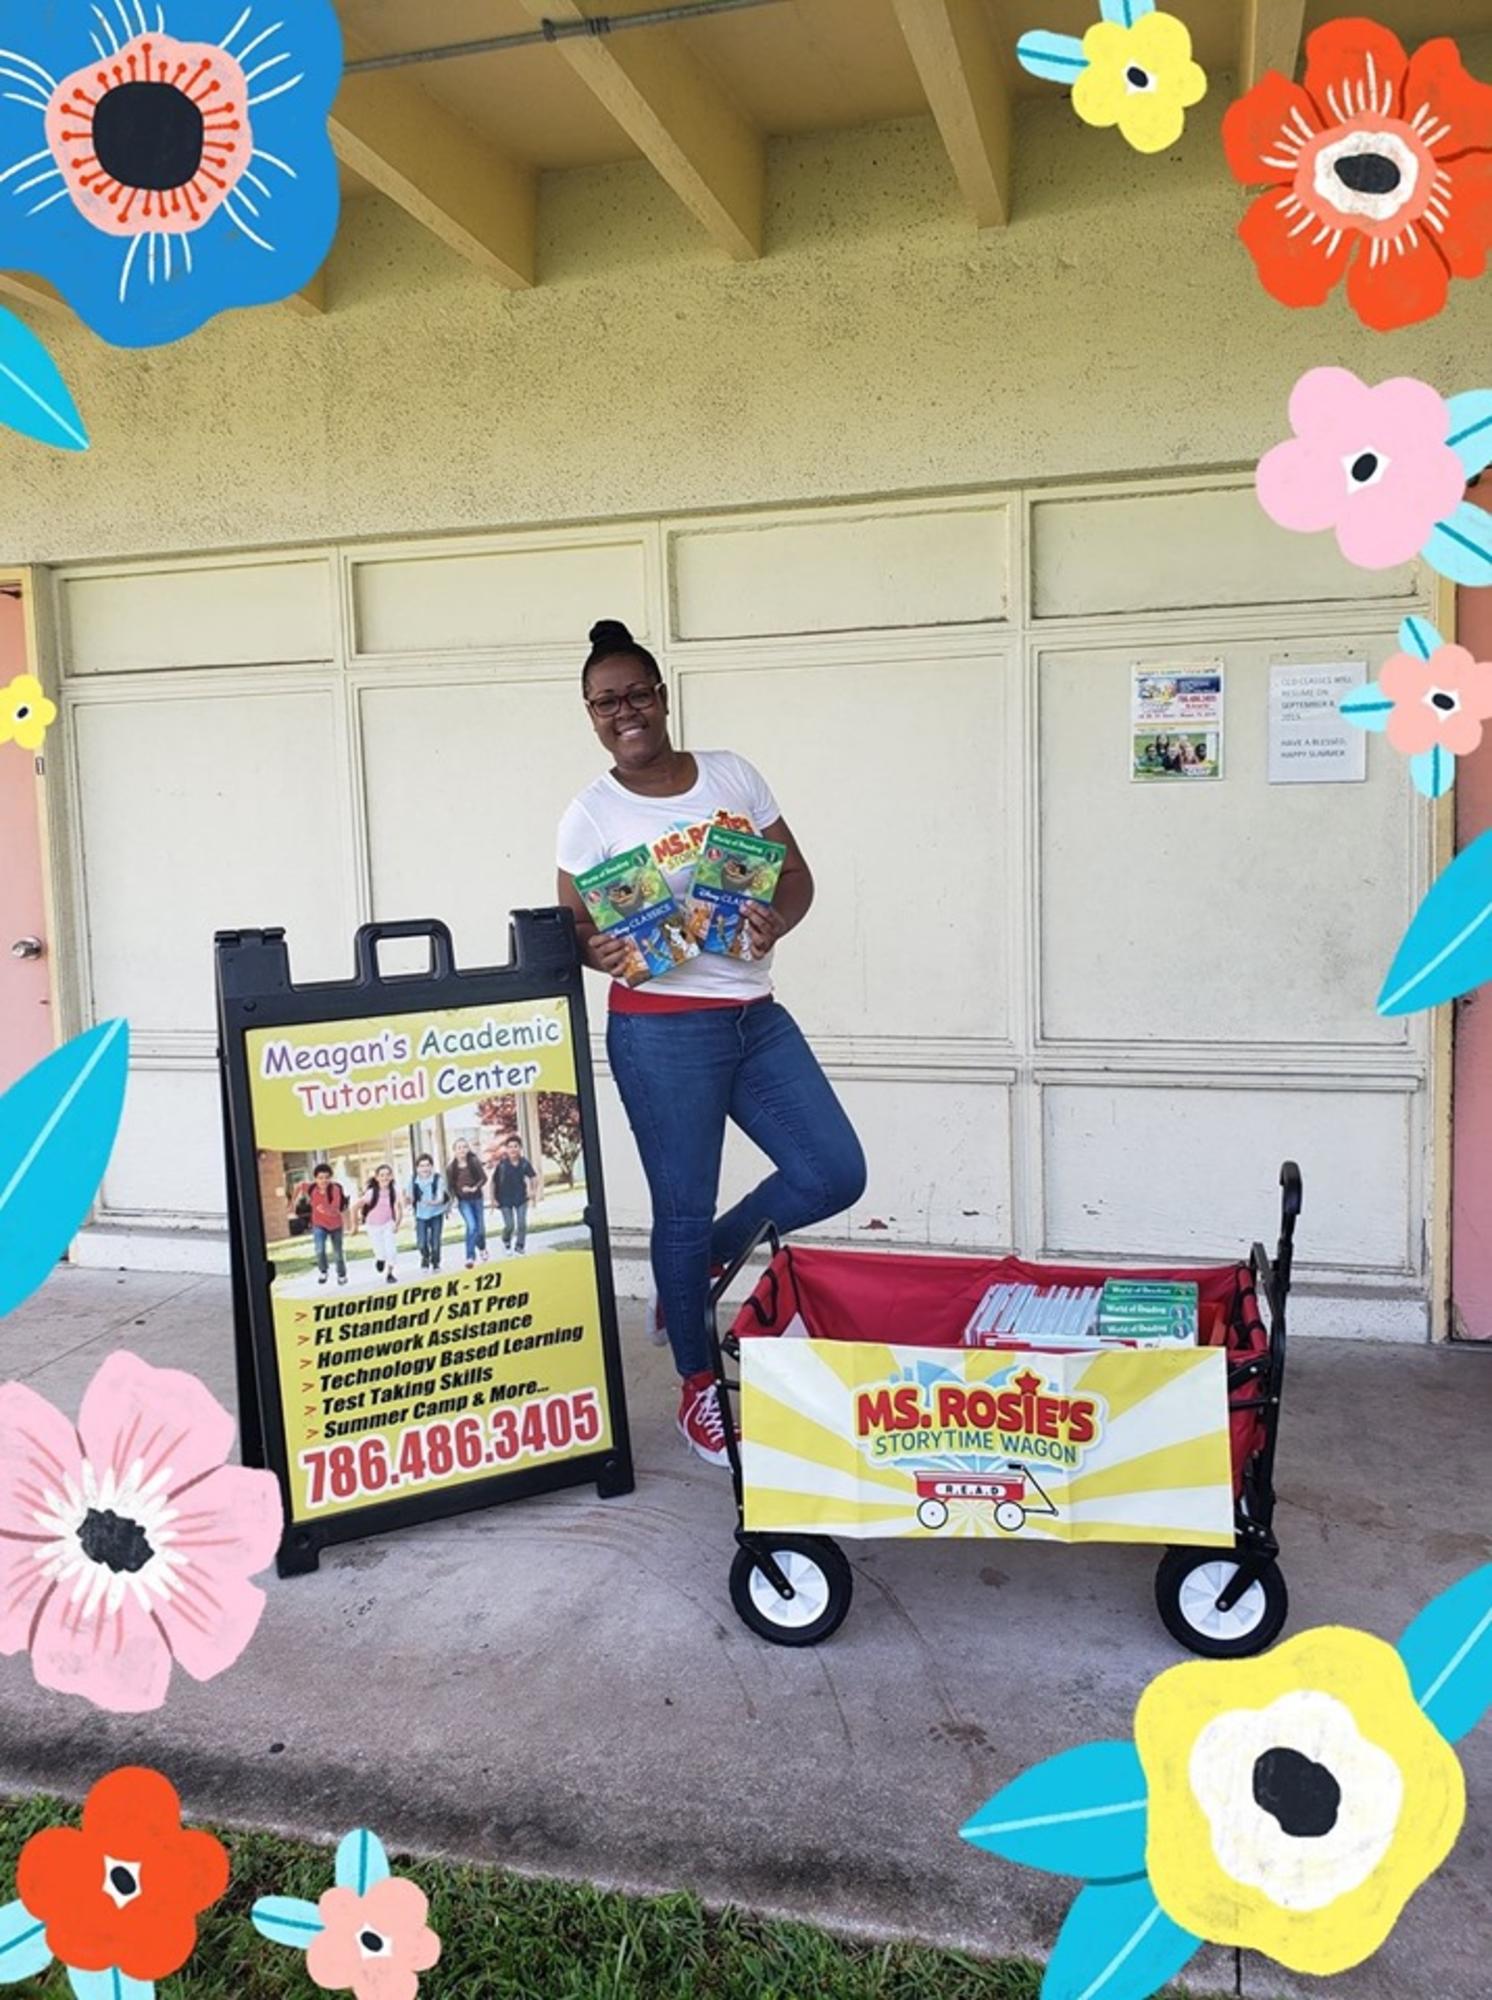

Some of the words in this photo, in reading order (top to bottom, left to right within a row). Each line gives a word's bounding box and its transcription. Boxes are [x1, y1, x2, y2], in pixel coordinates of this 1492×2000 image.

[1281, 701, 1327, 709] SEPTEMBER
[1316, 688, 1328, 697] ON
[1281, 751, 1307, 759] HAPPY
[1308, 749, 1345, 757] SUMMER
[653, 833, 691, 863] MS.
[629, 903, 672, 926] CLASSICS
[264, 1033, 408, 1075] Meagan's
[420, 1018, 560, 1056] Academic
[298, 1071, 425, 1112] Tutorial
[436, 1063, 538, 1095] Center
[313, 1291, 397, 1323] Tutoring
[402, 1280, 442, 1307] (Pre
[446, 1279, 460, 1298] K
[474, 1272, 502, 1292] 12)
[1106, 1303, 1128, 1314] World
[1129, 1304, 1136, 1313] of
[1137, 1304, 1167, 1315] Reading
[1111, 1286, 1133, 1294] World
[315, 1327, 334, 1346] FL
[338, 1308, 430, 1341] Standard
[432, 1306, 443, 1324] /
[446, 1298, 481, 1320] SAT
[485, 1291, 530, 1314] Prep
[317, 1336, 425, 1370] Homework
[427, 1313, 533, 1348] Assistance
[1107, 1325, 1128, 1334] World
[1139, 1323, 1168, 1333] Reading
[320, 1356, 436, 1393] Technology
[440, 1341, 499, 1368] Based
[503, 1325, 584, 1355] Learning
[323, 1391, 365, 1416] Test
[370, 1377, 435, 1407] Taking
[440, 1364, 493, 1387] Skills
[324, 1407, 409, 1439] Summer
[413, 1393, 468, 1420] Camp
[472, 1391, 486, 1407] &
[490, 1378, 550, 1404] More...
[857, 1388, 933, 1437] MS.
[938, 1385, 1096, 1443] ROSIE'S
[303, 1392, 600, 1504] 786.486.3405
[875, 1428, 994, 1456] STORYTIME
[999, 1433, 1077, 1464] WAGON
